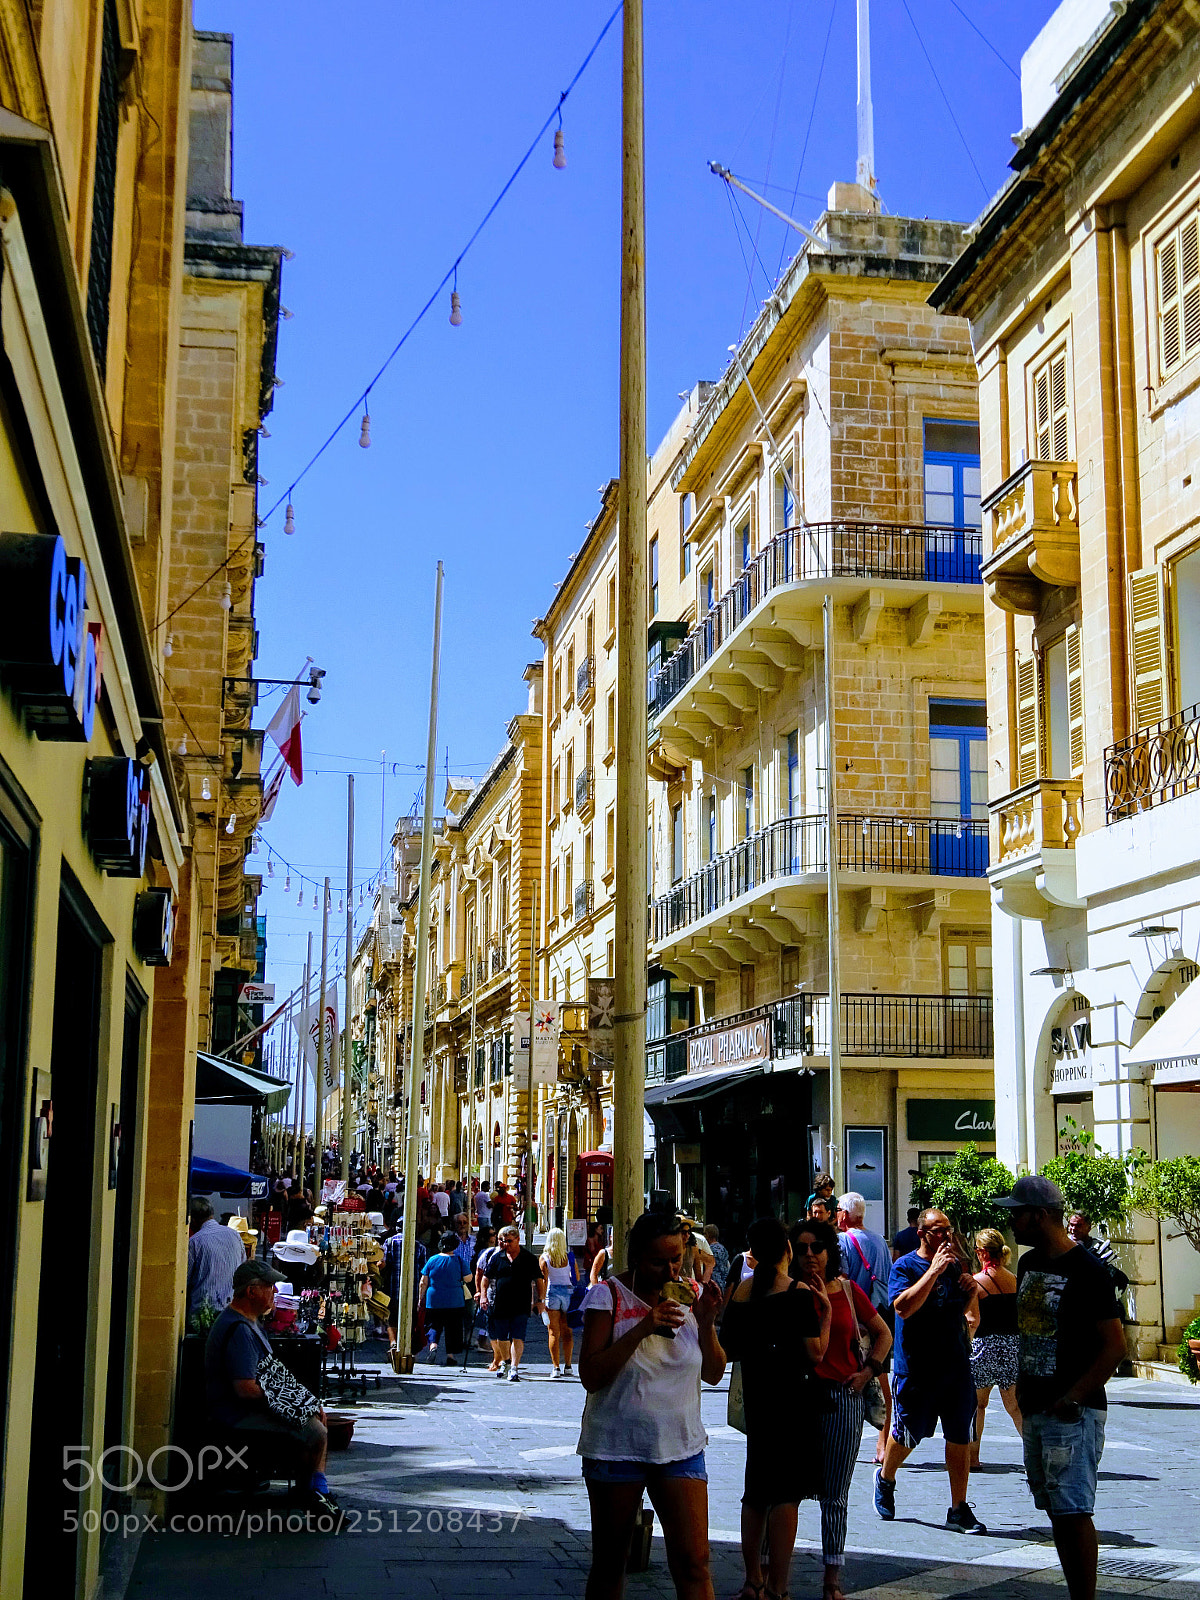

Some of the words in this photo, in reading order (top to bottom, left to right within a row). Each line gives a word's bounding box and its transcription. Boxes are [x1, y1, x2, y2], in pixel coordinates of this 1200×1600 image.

[690, 1037, 715, 1071] ROYAL
[718, 1021, 768, 1063] PHARMACY
[1050, 1066, 1087, 1083] SHOPPING
